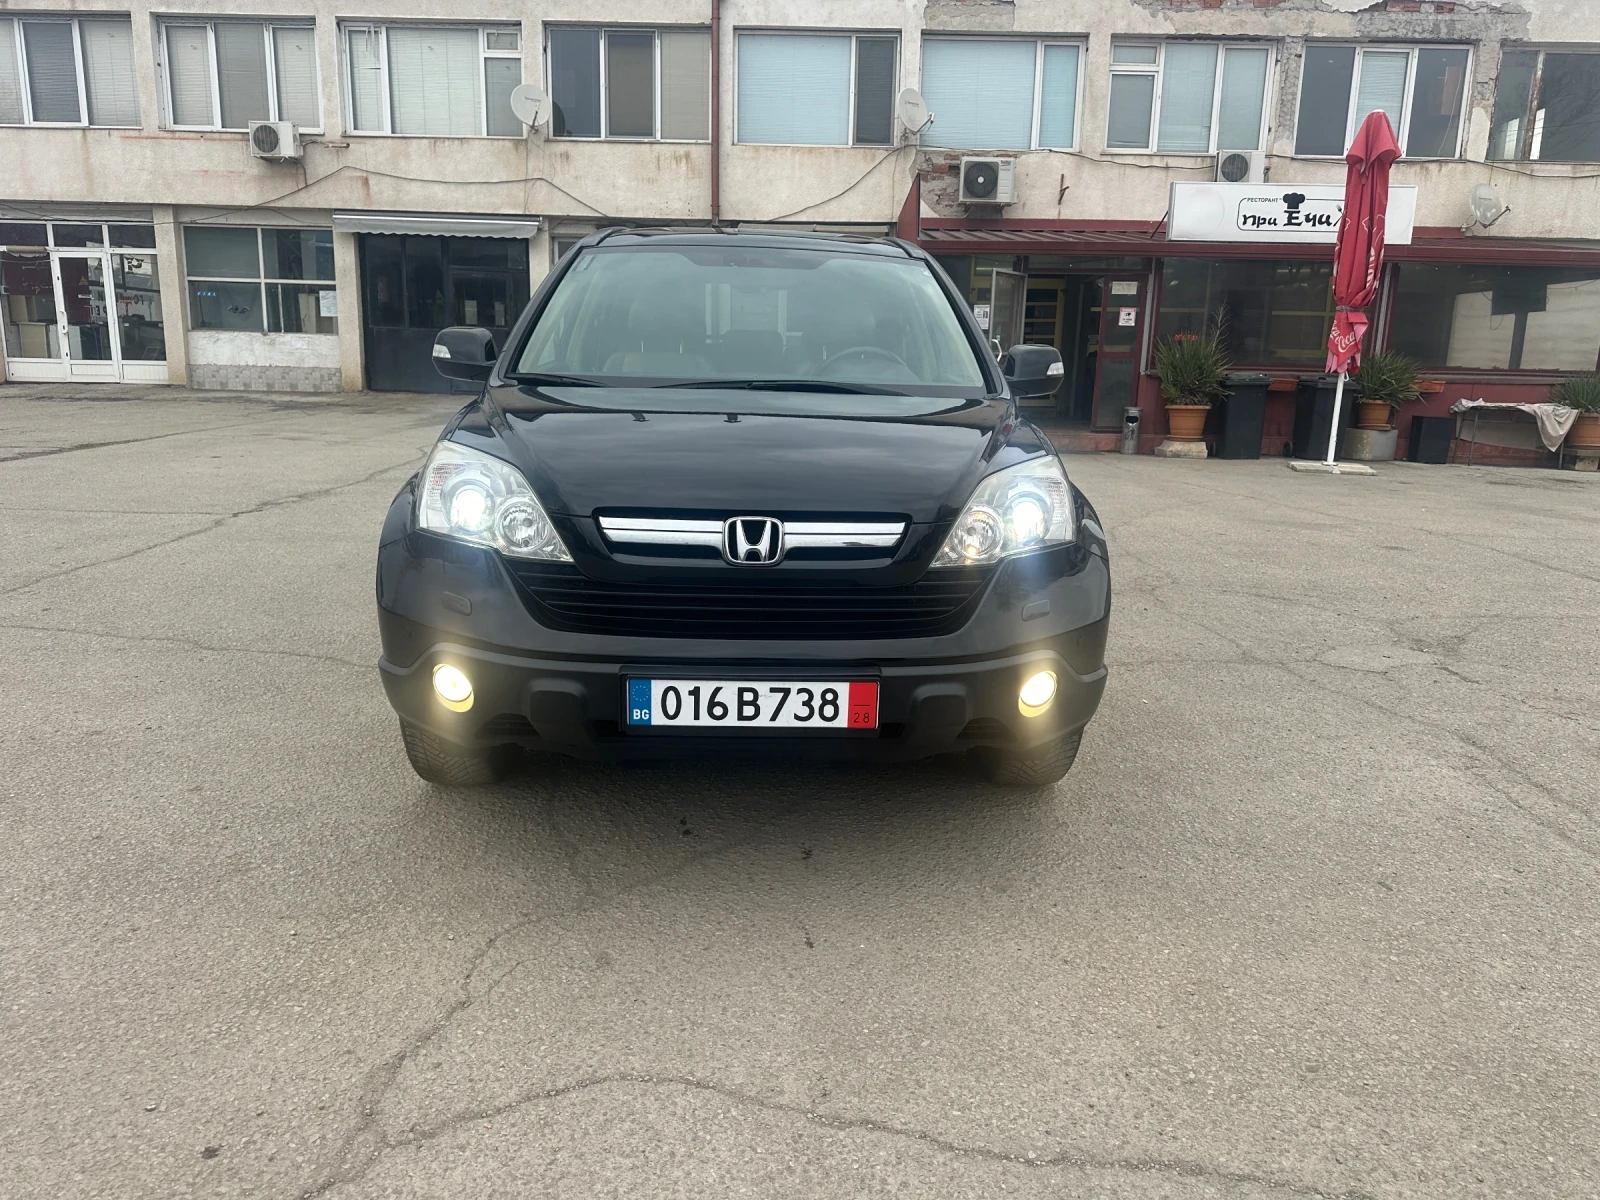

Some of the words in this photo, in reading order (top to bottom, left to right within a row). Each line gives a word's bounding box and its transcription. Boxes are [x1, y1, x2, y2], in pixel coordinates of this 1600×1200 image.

[660, 685, 840, 722] 016B738
[632, 708, 650, 720] BG
[853, 712, 870, 723] 28
